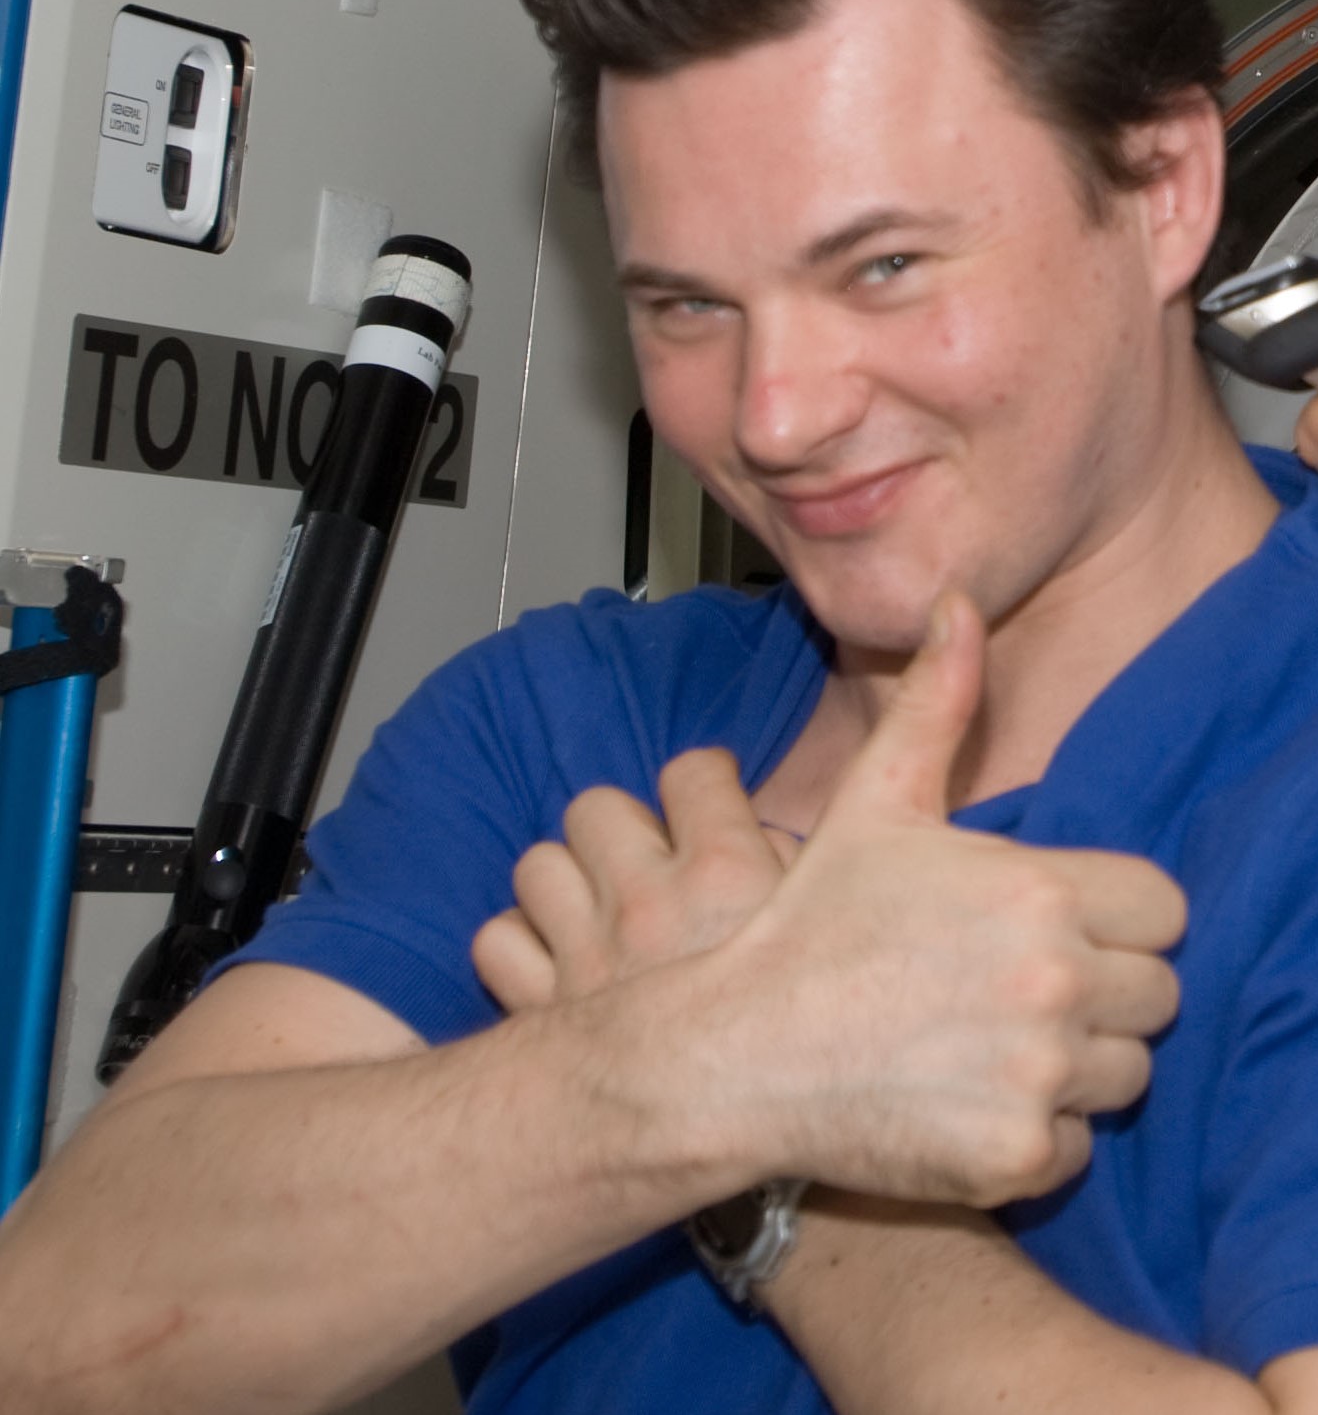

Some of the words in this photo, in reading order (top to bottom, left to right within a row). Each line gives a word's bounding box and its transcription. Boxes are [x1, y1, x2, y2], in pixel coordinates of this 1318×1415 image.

[155, 78, 168, 92] ON
[110, 102, 143, 122] GENERAL
[109, 116, 141, 136] LIGHTING
[146, 161, 161, 175] OFF
[84, 327, 199, 472] TO
[418, 383, 465, 502] 2
